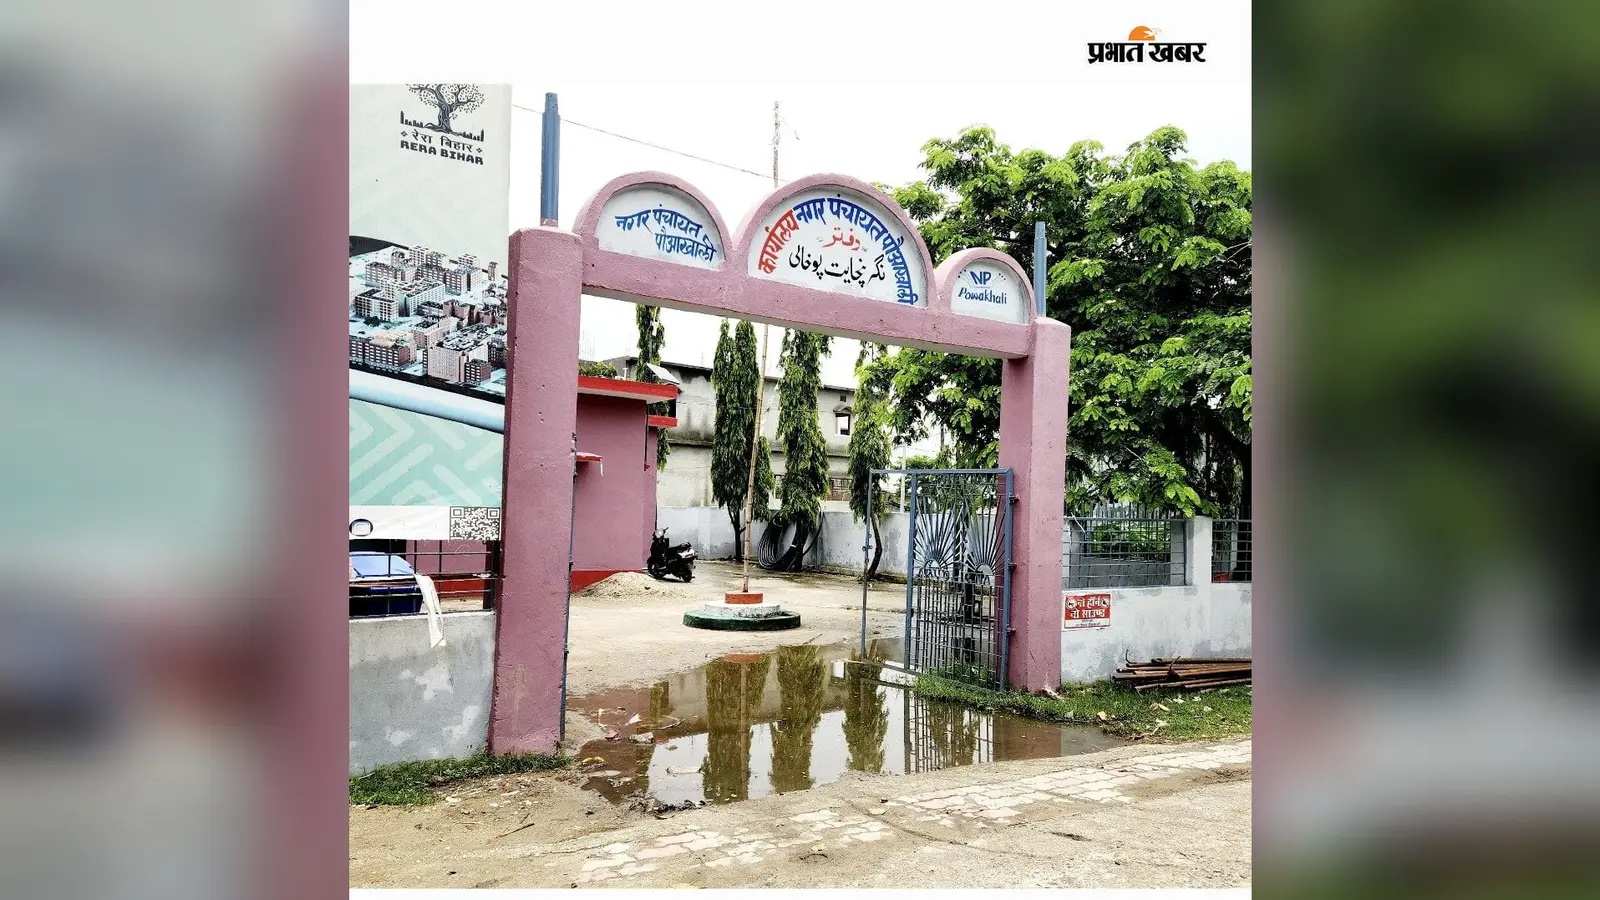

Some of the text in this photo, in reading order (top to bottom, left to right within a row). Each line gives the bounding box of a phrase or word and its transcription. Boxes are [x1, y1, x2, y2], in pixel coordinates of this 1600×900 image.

[400, 140, 484, 165] RERA BIHAR
[411, 128, 473, 152] रेरा बिहार
[614, 203, 703, 238] नगर पंचायत
[793, 197, 827, 225] नगर
[827, 193, 889, 242] पंचायत
[655, 226, 717, 262] पौआखाली
[823, 227, 861, 251] دفتر
[866, 254, 886, 286] نگر
[969, 271, 992, 285] NP
[958, 287, 1007, 304] Powakhali
